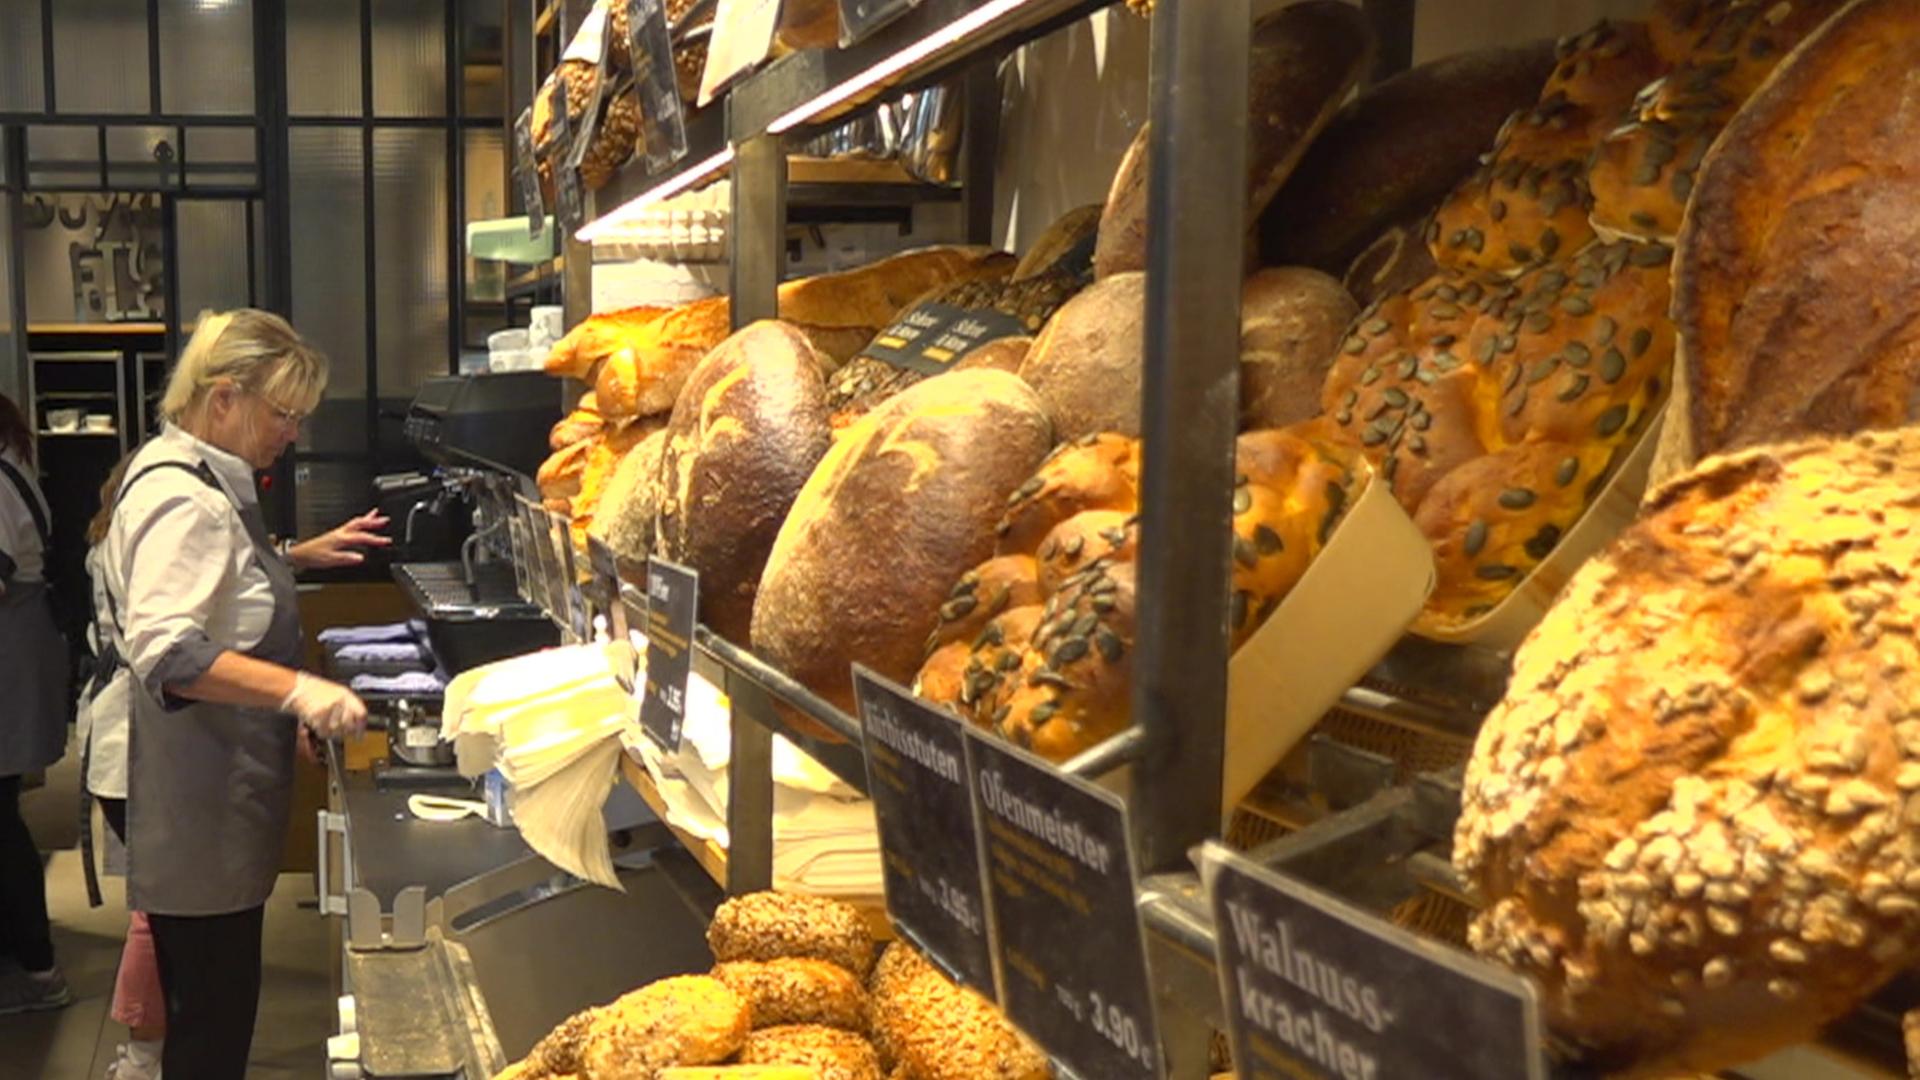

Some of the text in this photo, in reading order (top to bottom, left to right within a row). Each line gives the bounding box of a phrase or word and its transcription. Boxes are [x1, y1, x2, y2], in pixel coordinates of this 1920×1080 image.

[980, 769, 1109, 875] Ofenmeister
[1226, 901, 1395, 1034] Walnuss-
[1089, 990, 1140, 1059] 3.90
[1236, 966, 1378, 1080] kracher
